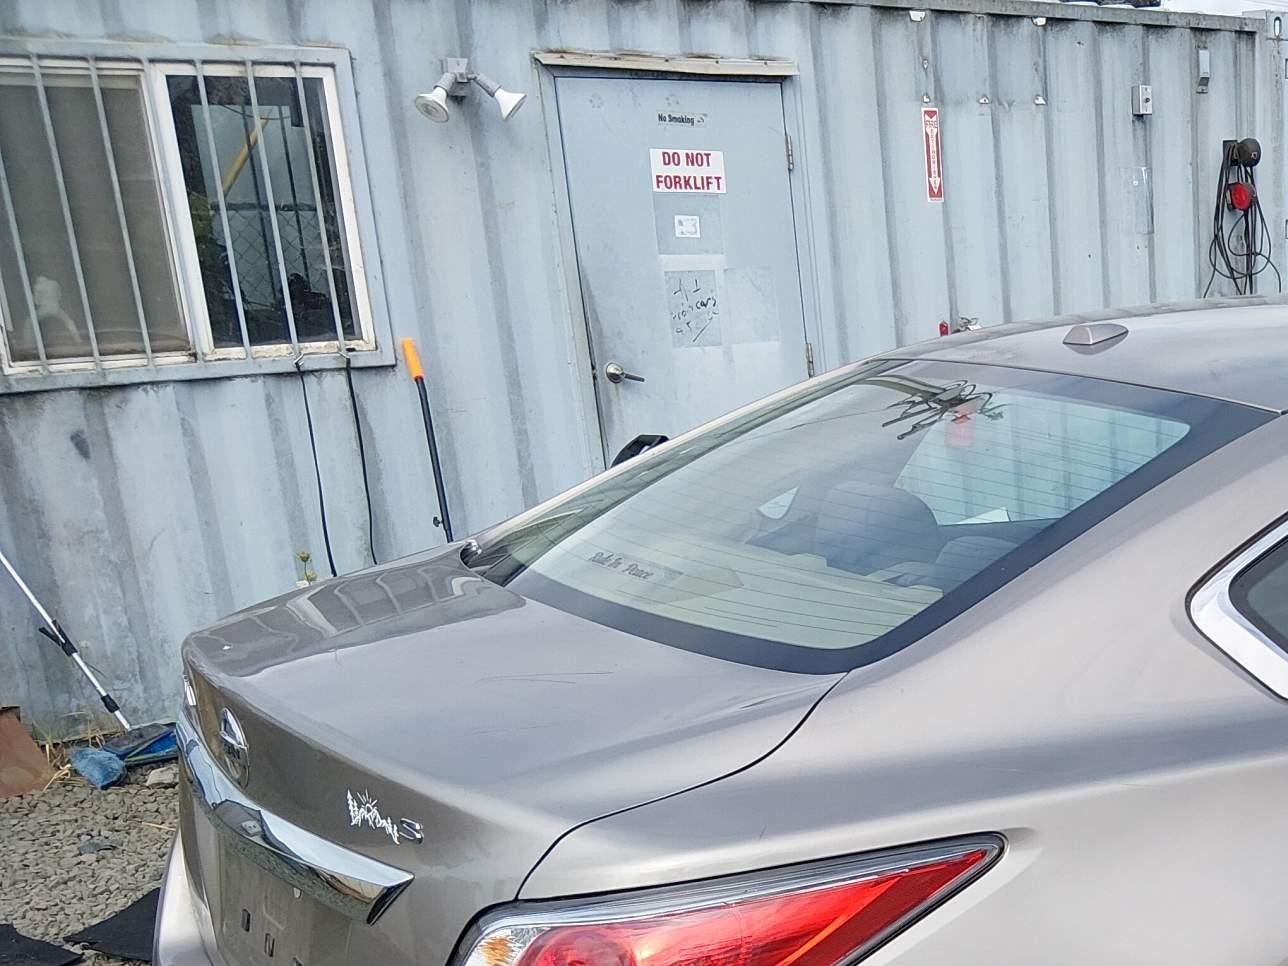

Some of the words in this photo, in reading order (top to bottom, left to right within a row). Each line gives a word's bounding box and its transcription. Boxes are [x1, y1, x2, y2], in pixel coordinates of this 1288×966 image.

[658, 113, 667, 122] No
[668, 114, 695, 127] Smoking
[662, 151, 681, 166] DO
[685, 152, 711, 167] NOT
[655, 174, 722, 191] FORKLIFT
